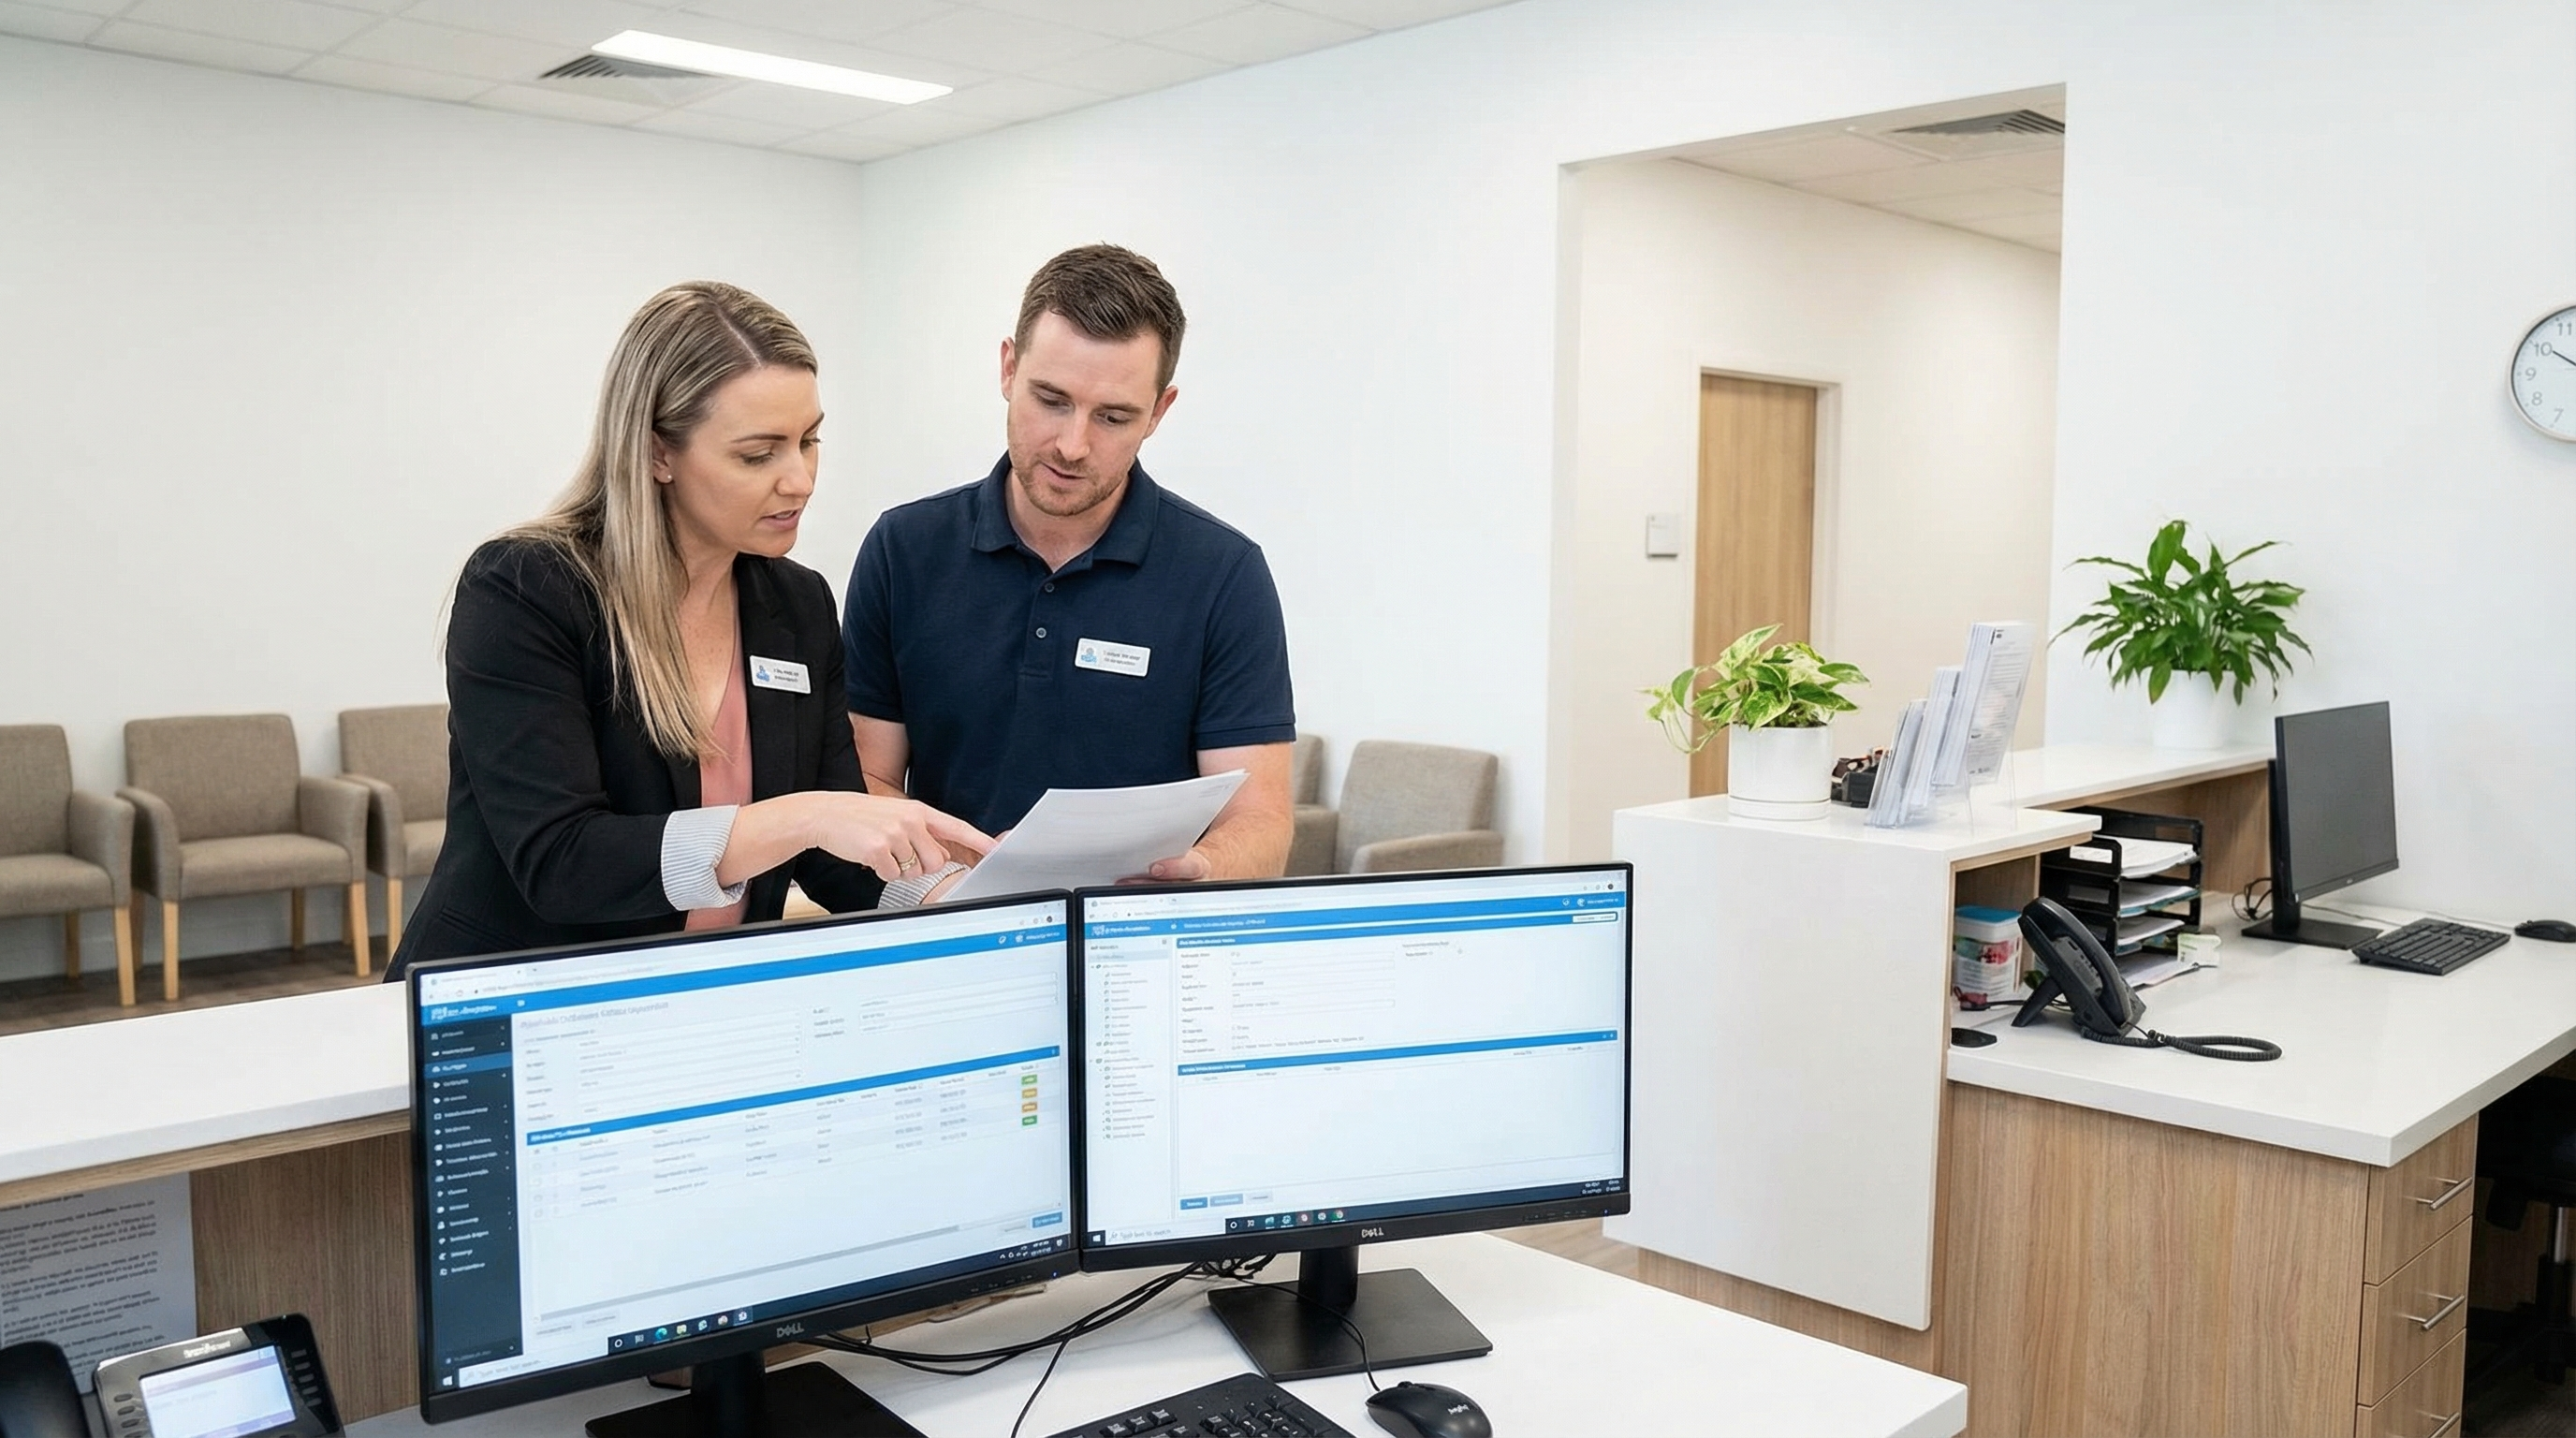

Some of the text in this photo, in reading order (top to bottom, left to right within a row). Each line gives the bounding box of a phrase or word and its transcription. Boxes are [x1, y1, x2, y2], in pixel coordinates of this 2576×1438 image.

[2557, 322, 2572, 336] 11
[2534, 342, 2553, 357] 10
[2525, 367, 2537, 381] 9
[2531, 391, 2543, 406] 8
[2554, 408, 2565, 422] 7
